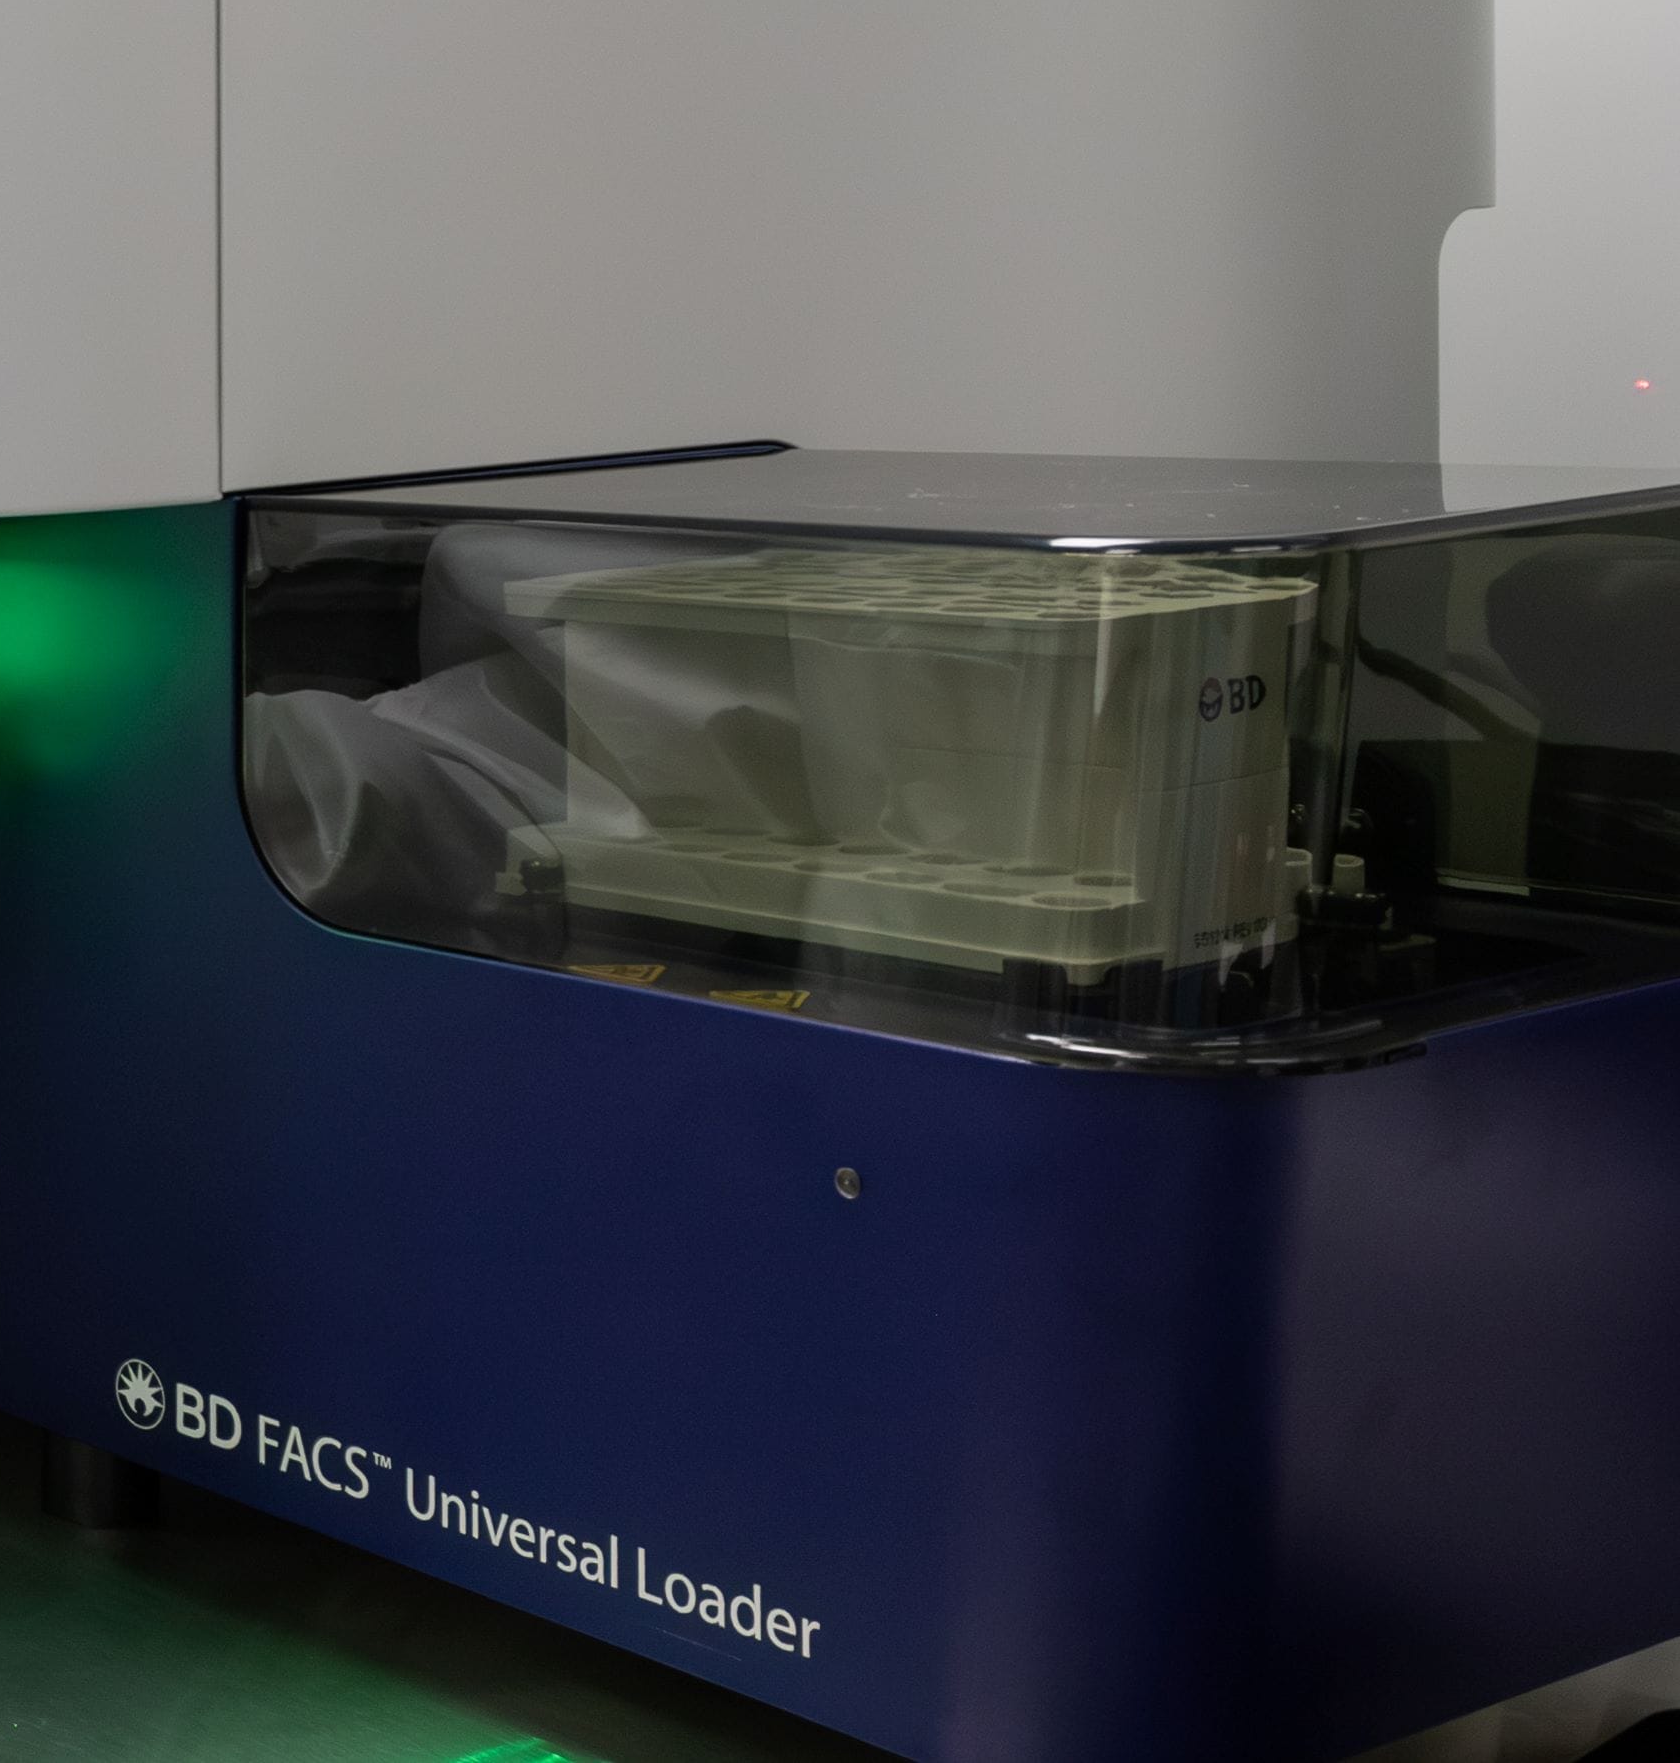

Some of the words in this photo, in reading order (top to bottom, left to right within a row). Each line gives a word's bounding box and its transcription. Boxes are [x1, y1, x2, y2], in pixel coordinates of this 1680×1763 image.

[1227, 675, 1267, 714] BD
[176, 1382, 242, 1450] BD
[406, 1467, 620, 1589] Universal
[637, 1546, 822, 1659] Loader
